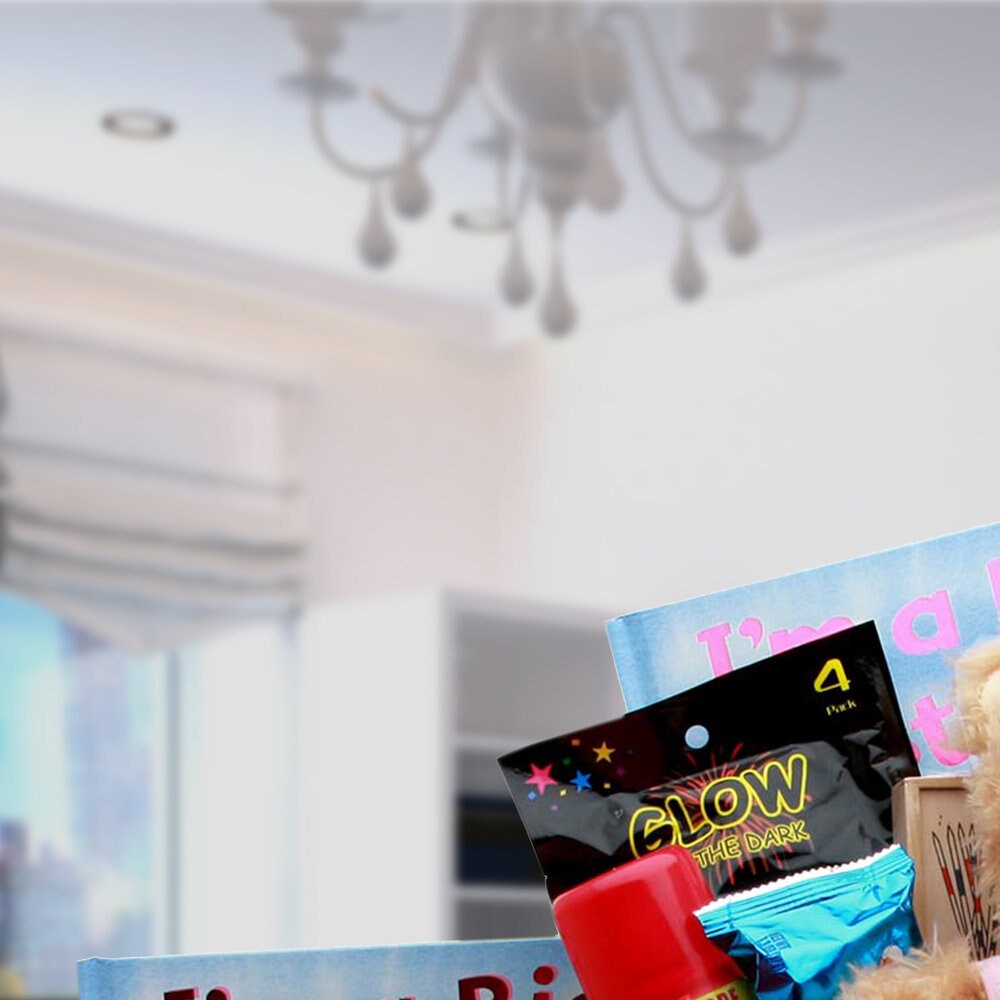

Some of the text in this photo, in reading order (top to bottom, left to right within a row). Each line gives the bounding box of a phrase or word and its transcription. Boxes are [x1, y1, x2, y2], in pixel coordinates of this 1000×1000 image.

[892, 589, 961, 656] a
[813, 658, 851, 692] 4
[826, 699, 857, 716] Pack
[629, 752, 808, 859] GLOW
[693, 820, 811, 869] THE DARK
